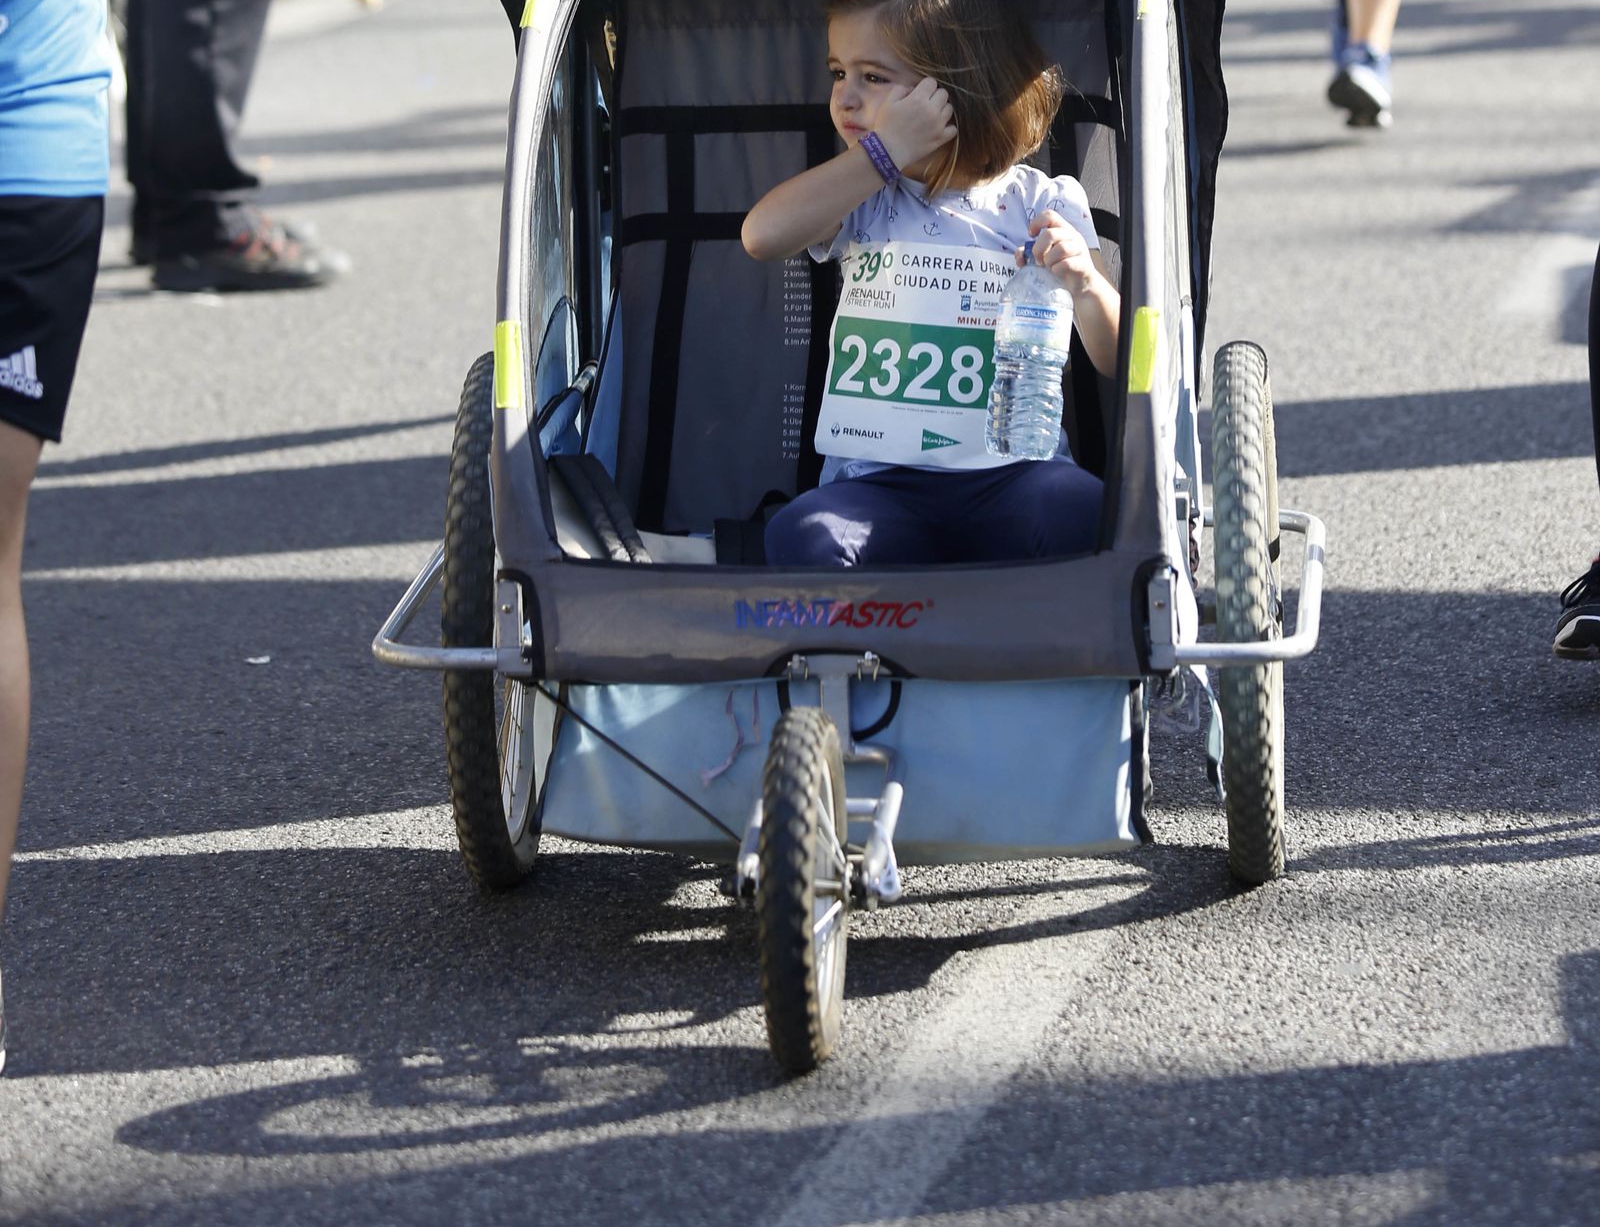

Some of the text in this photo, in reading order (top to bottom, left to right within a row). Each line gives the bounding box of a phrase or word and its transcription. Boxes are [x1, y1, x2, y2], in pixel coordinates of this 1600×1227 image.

[901, 254, 974, 272] CARRERA
[894, 275, 951, 290] CIUDAD
[958, 279, 977, 292] DE
[850, 288, 891, 301] RENAULT
[848, 297, 891, 309] STREET RUN
[957, 317, 981, 325] MINI
[843, 427, 885, 439] RENAULT
